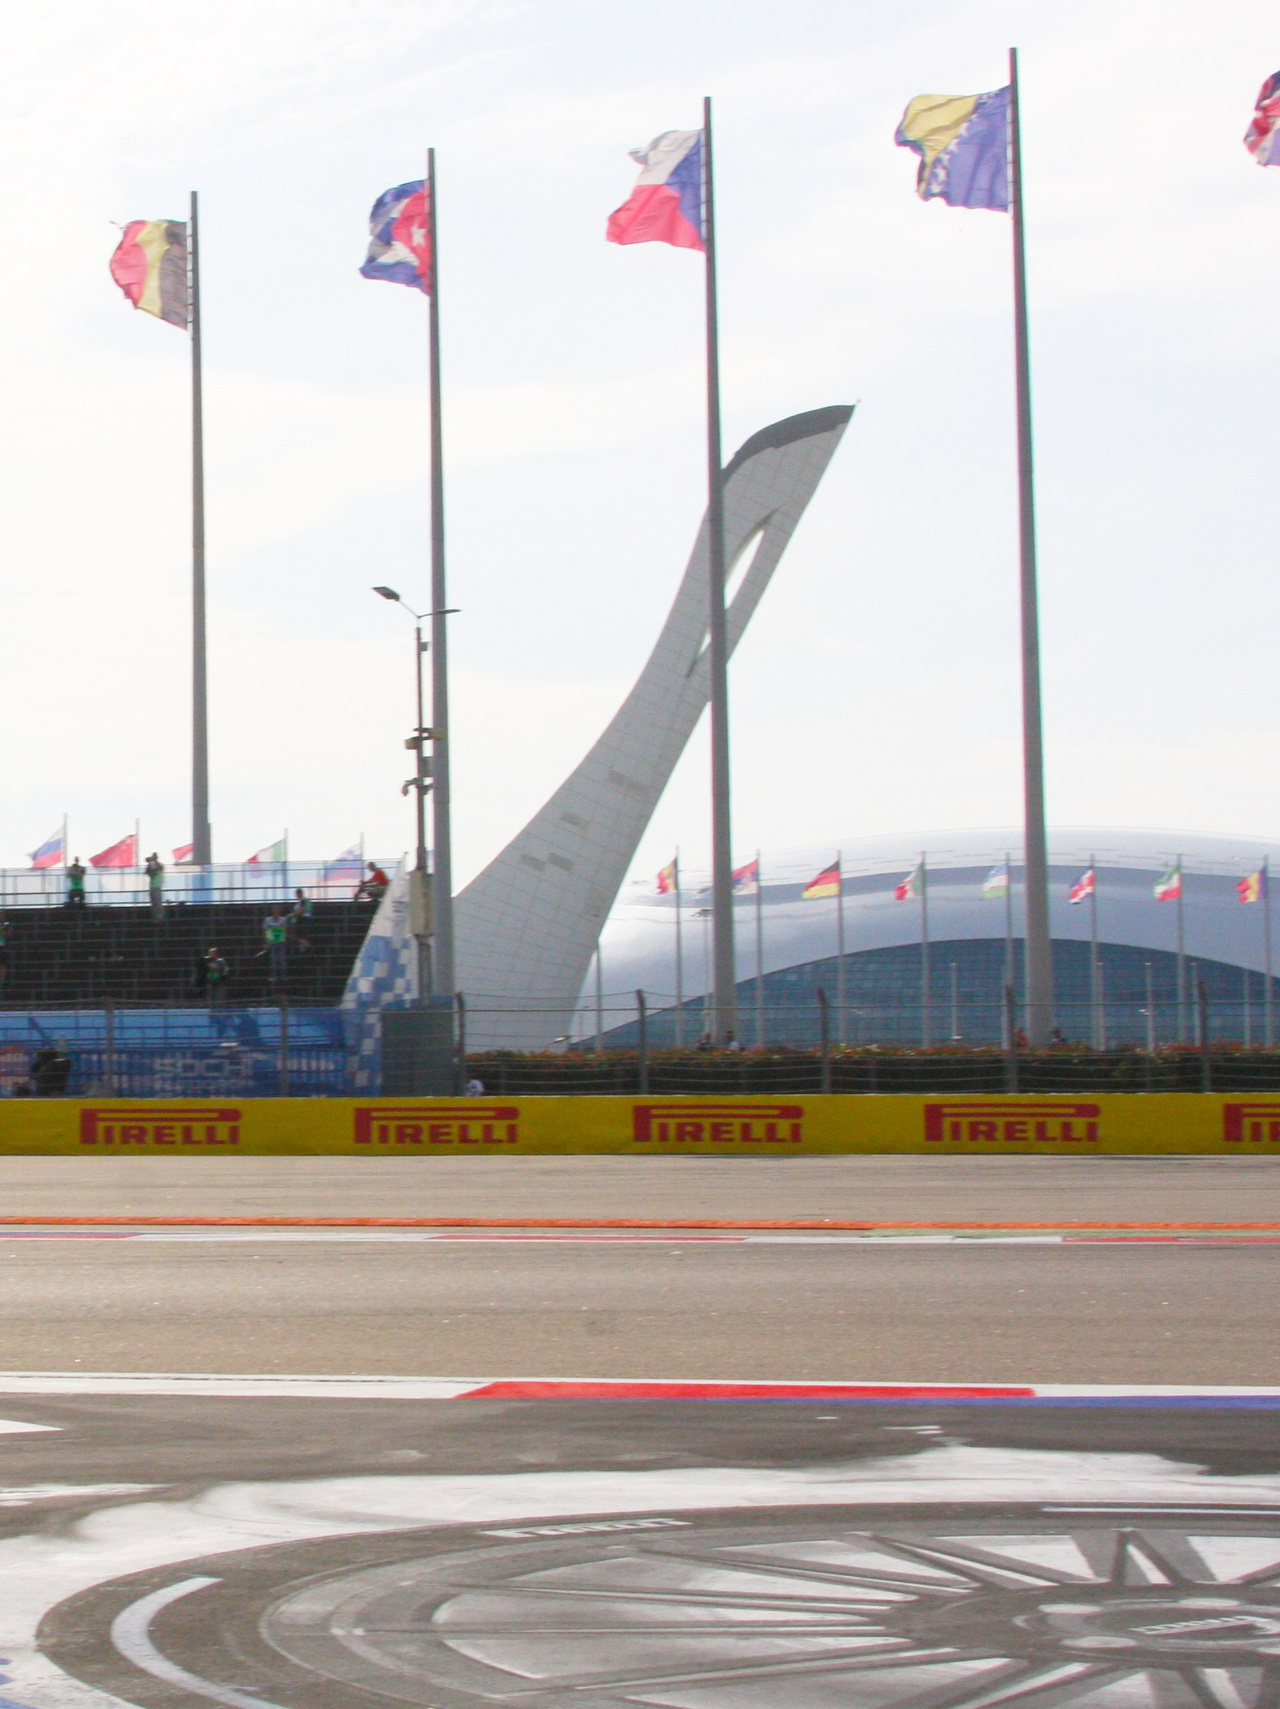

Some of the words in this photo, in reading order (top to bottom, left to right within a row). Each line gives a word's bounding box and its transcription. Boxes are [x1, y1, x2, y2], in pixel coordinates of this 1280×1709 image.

[80, 1108, 242, 1145] PIRELLI
[353, 1107, 519, 1144] PIRELLI
[632, 1105, 805, 1143] PIRELLI
[924, 1103, 1101, 1142] PIRELLI
